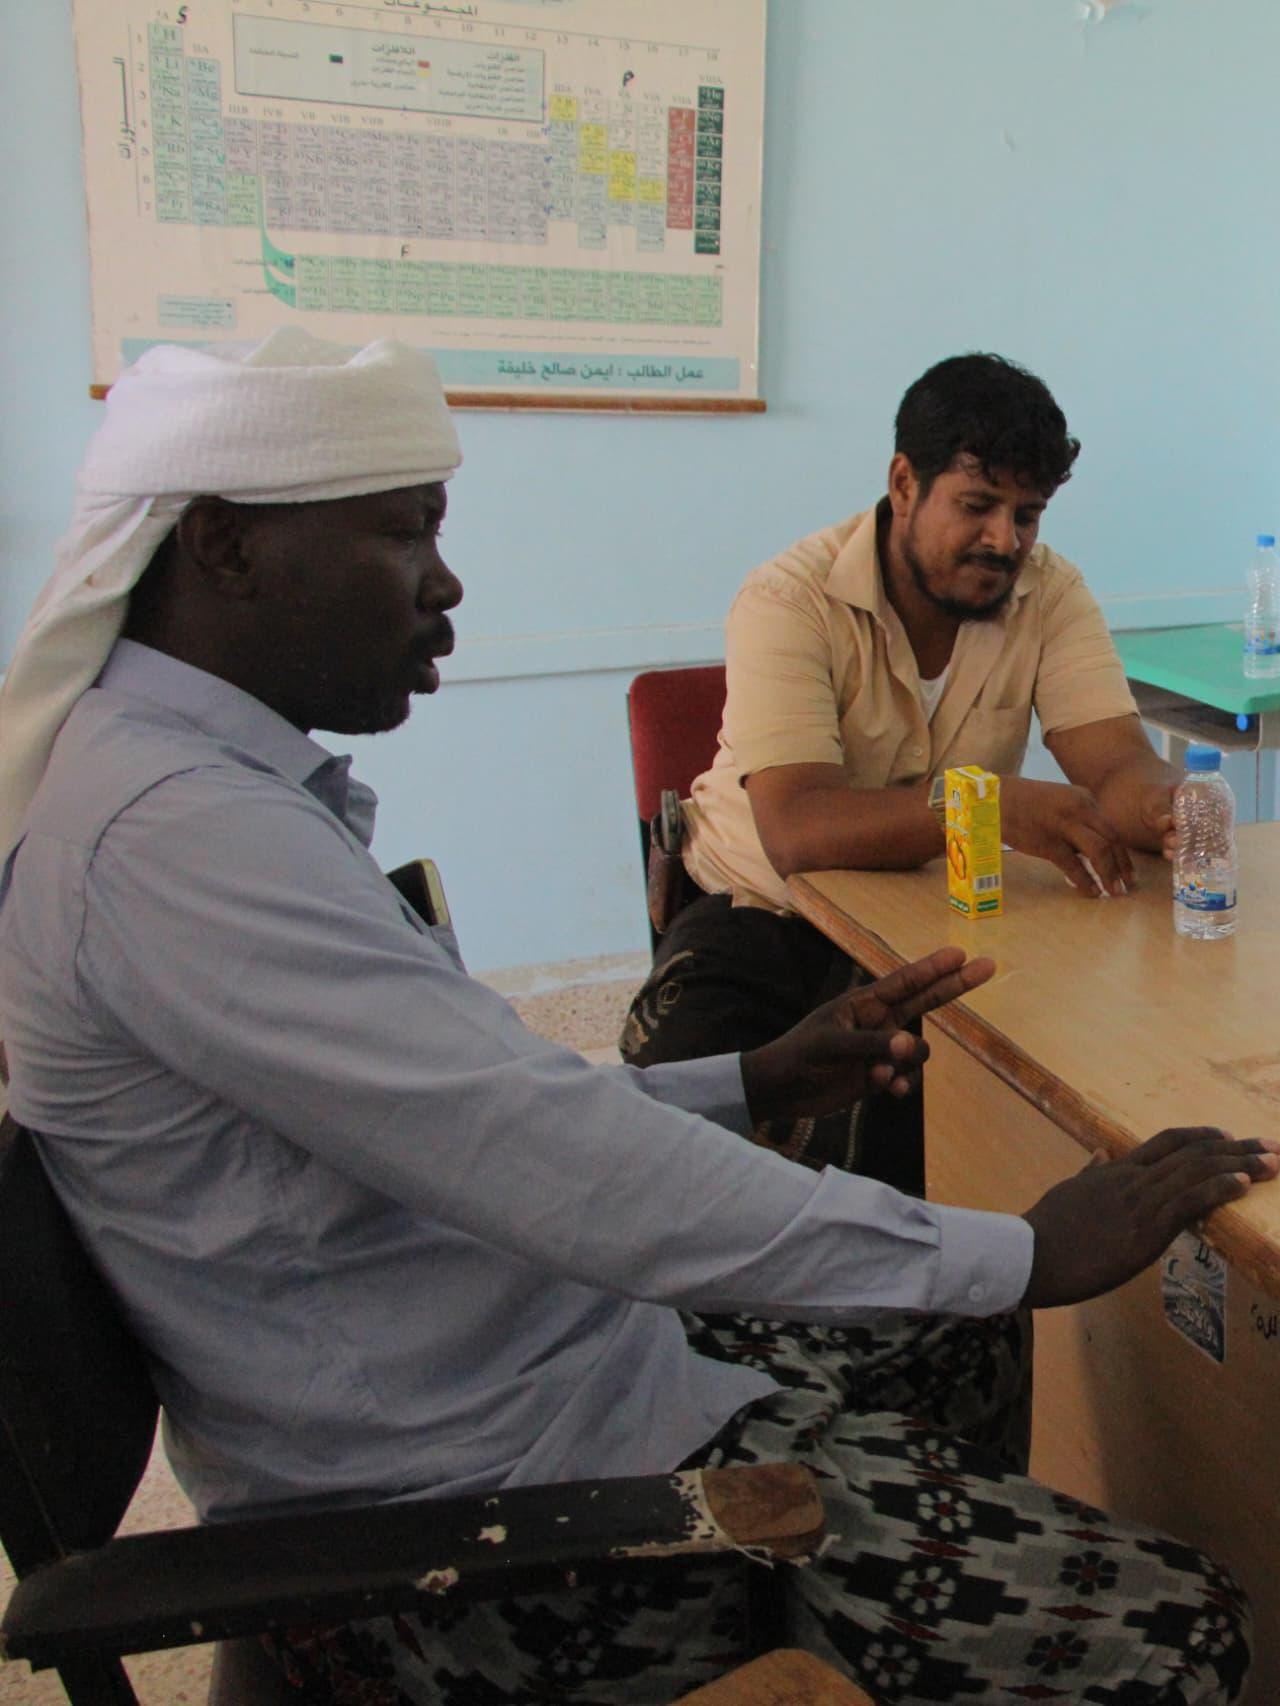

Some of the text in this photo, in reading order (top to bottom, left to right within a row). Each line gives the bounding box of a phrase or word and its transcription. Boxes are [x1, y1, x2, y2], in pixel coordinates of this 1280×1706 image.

[176, 5, 191, 25] S
[400, 244, 411, 258] F
[497, 359, 537, 379] خليفة
[540, 362, 576, 381] صالح
[626, 363, 672, 381] الطالب
[675, 366, 704, 382] عمل
